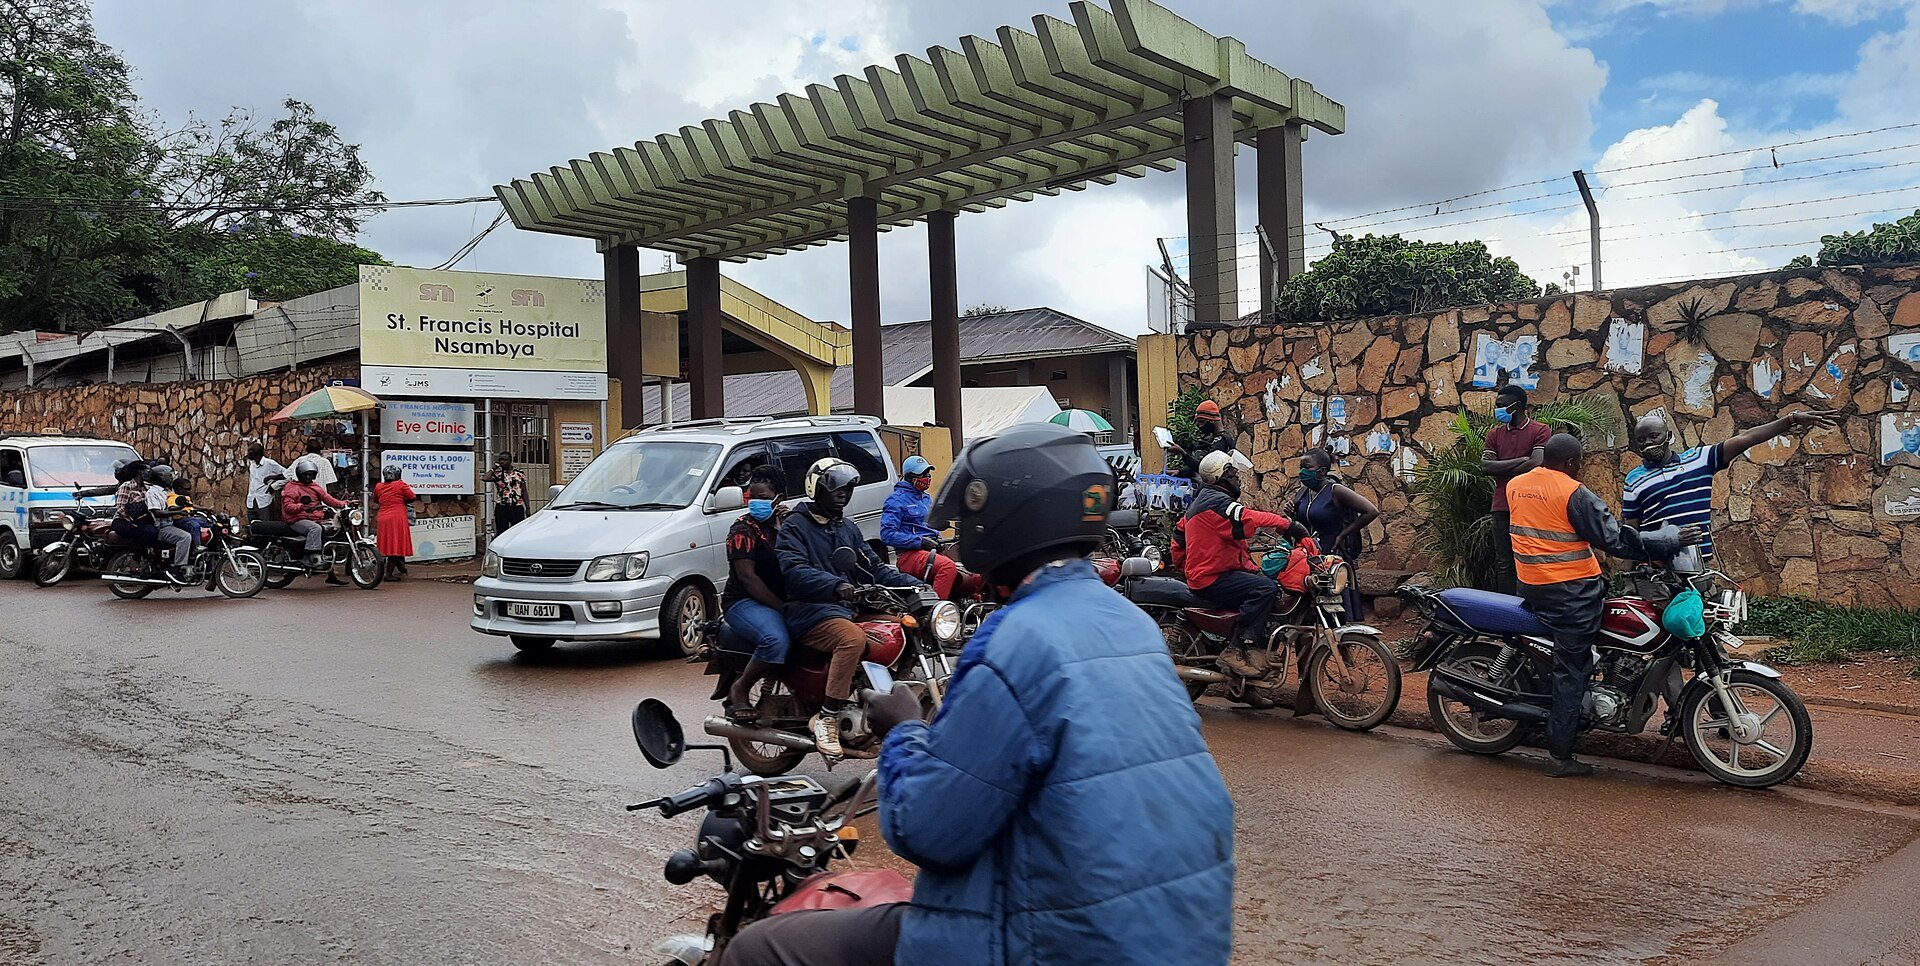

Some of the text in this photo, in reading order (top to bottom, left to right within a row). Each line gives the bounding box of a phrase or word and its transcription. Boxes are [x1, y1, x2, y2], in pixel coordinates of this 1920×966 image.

[387, 313, 579, 339] St. Francis Hospital
[435, 337, 534, 359] Nsambya
[396, 420, 466, 434] Eye Clinic
[440, 455, 470, 463] 1,000/-
[429, 516, 473, 525] SPECTACLES
[533, 605, 555, 617] 681V
